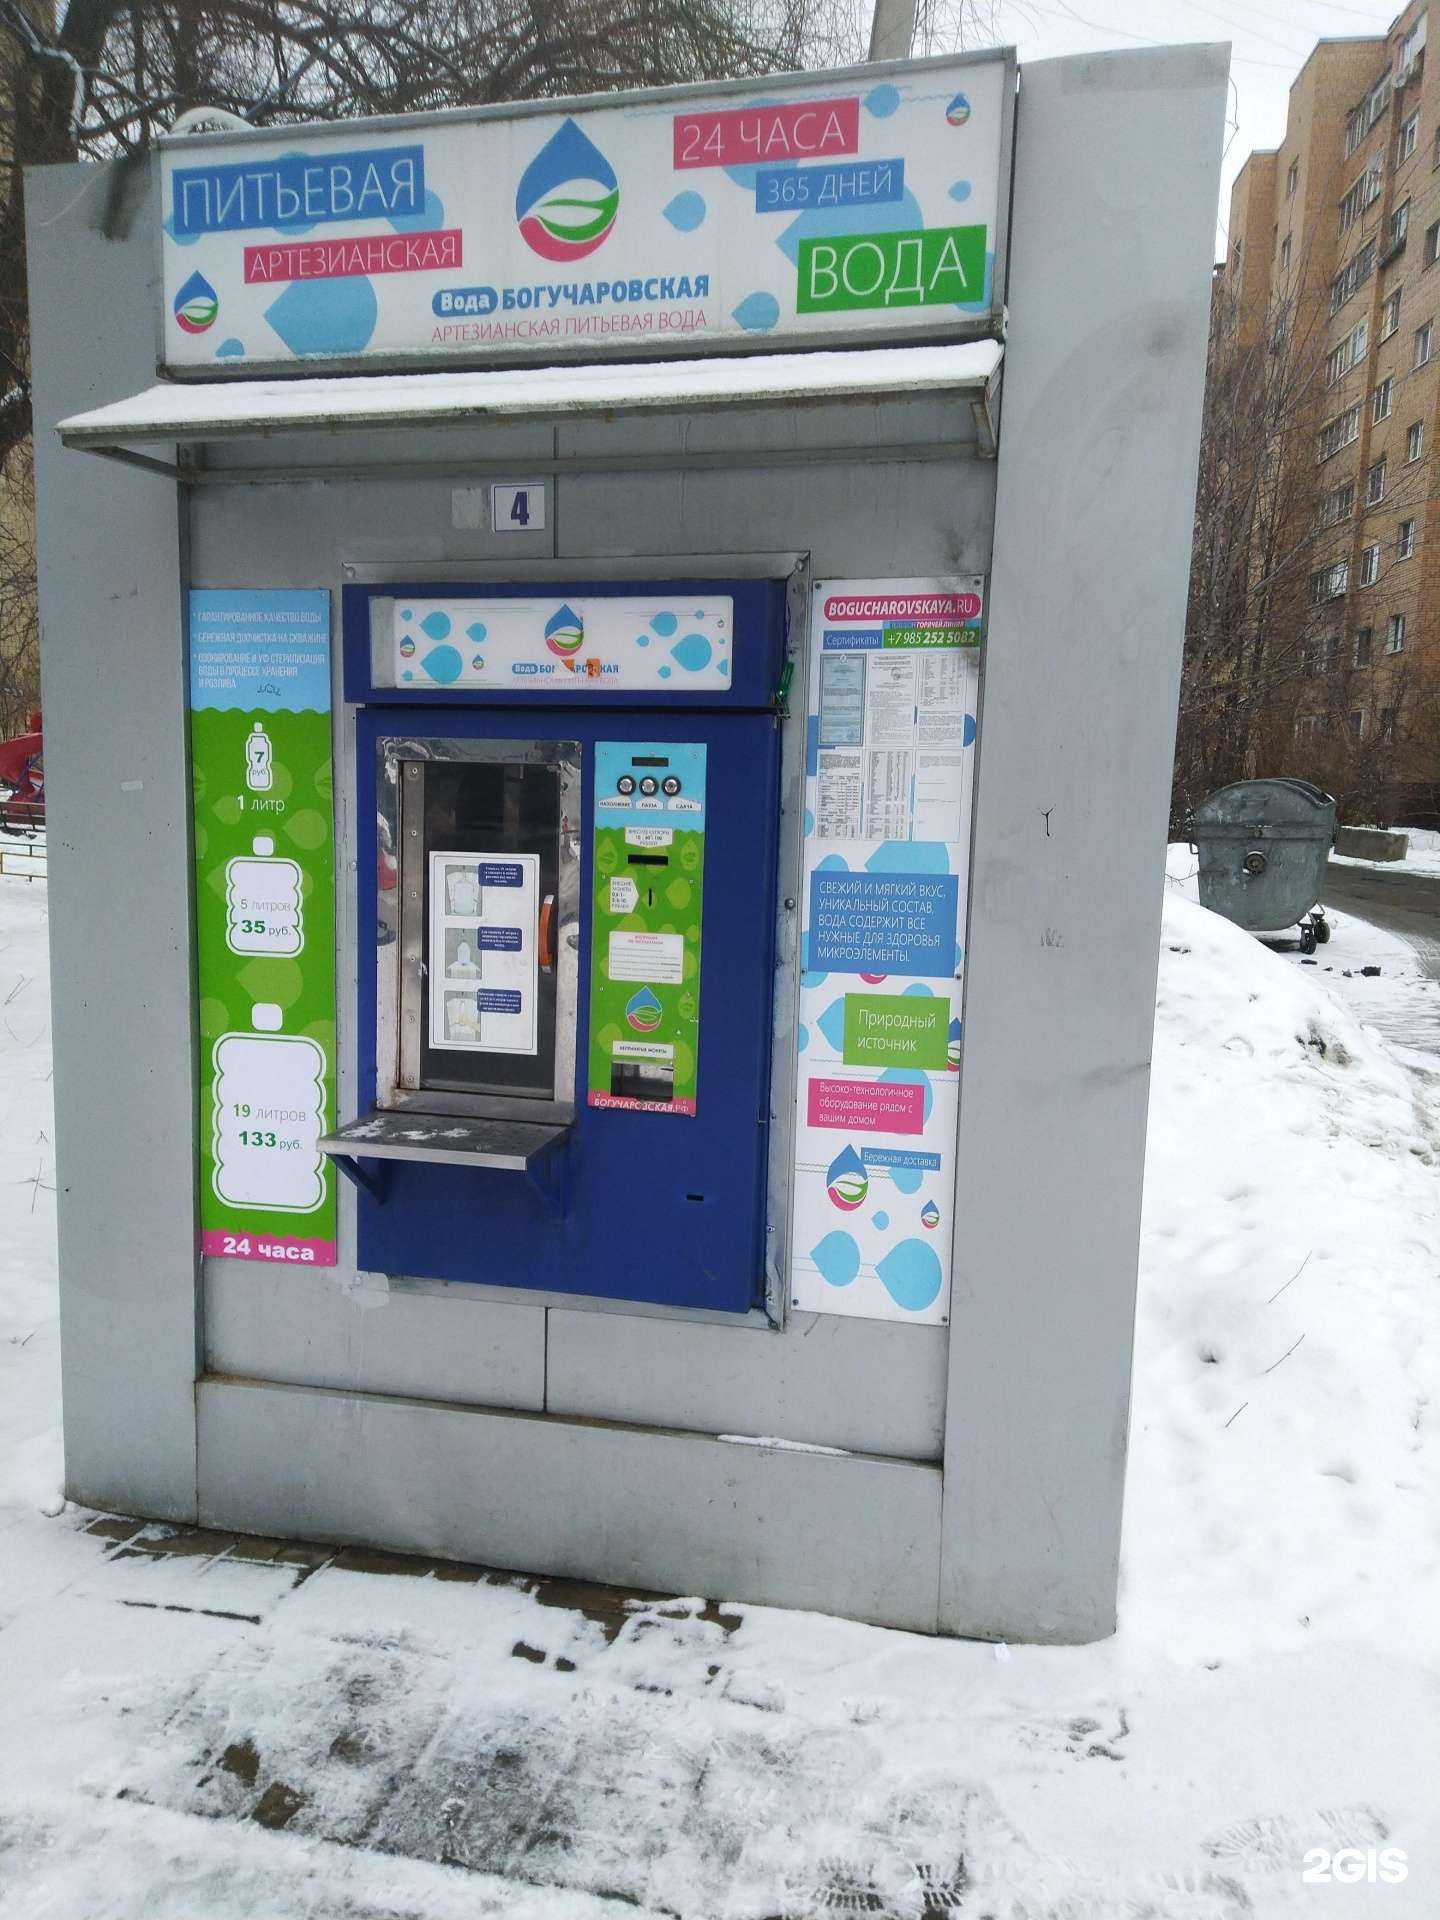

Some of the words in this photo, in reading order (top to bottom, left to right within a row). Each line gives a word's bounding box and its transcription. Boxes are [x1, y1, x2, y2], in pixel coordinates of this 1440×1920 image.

[682, 123, 725, 162] 24
[740, 111, 846, 155] ЧАСА
[181, 157, 416, 228] ПИТЬЕВАЯ
[767, 177, 809, 205] 365
[818, 164, 892, 204] ДНЕЙ
[249, 236, 457, 281] АРТЕЗИАНСКАЯ
[809, 236, 968, 306] ВОДА
[440, 289, 491, 314] Вода
[502, 275, 710, 310] БОГУЧАРОВСКАЯ
[432, 319, 560, 343] АРТЕЗИАНСКАЯ
[564, 313, 653, 338] ПИТЬЕВАЯ
[658, 309, 707, 331] ВОДА
[510, 491, 530, 525] 4
[828, 599, 973, 617] BOGUCHAROVSKAYA.RU
[826, 634, 879, 648] Сертификаты
[888, 633, 901, 645] +7
[904, 632, 921, 644] 985
[922, 632, 943, 644] 252
[254, 751, 265, 763] 7
[237, 794, 245, 811] 1
[251, 799, 285, 817] литр
[819, 880, 863, 895] СВЕЖИЙ
[864, 883, 873, 895] И
[875, 881, 917, 897] МЯГКИЙ
[240, 899, 248, 911] 5
[251, 902, 292, 915] литров
[818, 897, 889, 912] УНИКАЛЬНЫЙ
[241, 920, 266, 935] 35
[268, 925, 292, 937] руб.
[818, 914, 847, 928] ВОДА
[849, 915, 905, 930] СОДЕРЖИТ
[907, 917, 926, 930] ВСЕ
[818, 931, 861, 944] НУЖНЫЕ
[862, 932, 884, 946] ДЛЯ
[886, 934, 941, 947] ЗДОРОВЬЯ
[817, 947, 911, 963] МИКРОЭЛЕМЕНТЫ.
[858, 1008, 937, 1030] Природный
[857, 1037, 918, 1051] источник
[819, 1082, 914, 1099] Высоко-технологичное
[233, 1103, 251, 1118] 19
[256, 1107, 307, 1123] литров
[819, 1097, 878, 1111] оборудование
[879, 1102, 906, 1114] рядом
[908, 1104, 913, 1113] с
[819, 1113, 846, 1123] вашим
[848, 1115, 876, 1126] домом
[238, 1131, 277, 1148] 133
[279, 1137, 304, 1151] руб.
[903, 1156, 937, 1167] доставка
[222, 1237, 251, 1256] 24
[257, 1244, 315, 1262] часа
